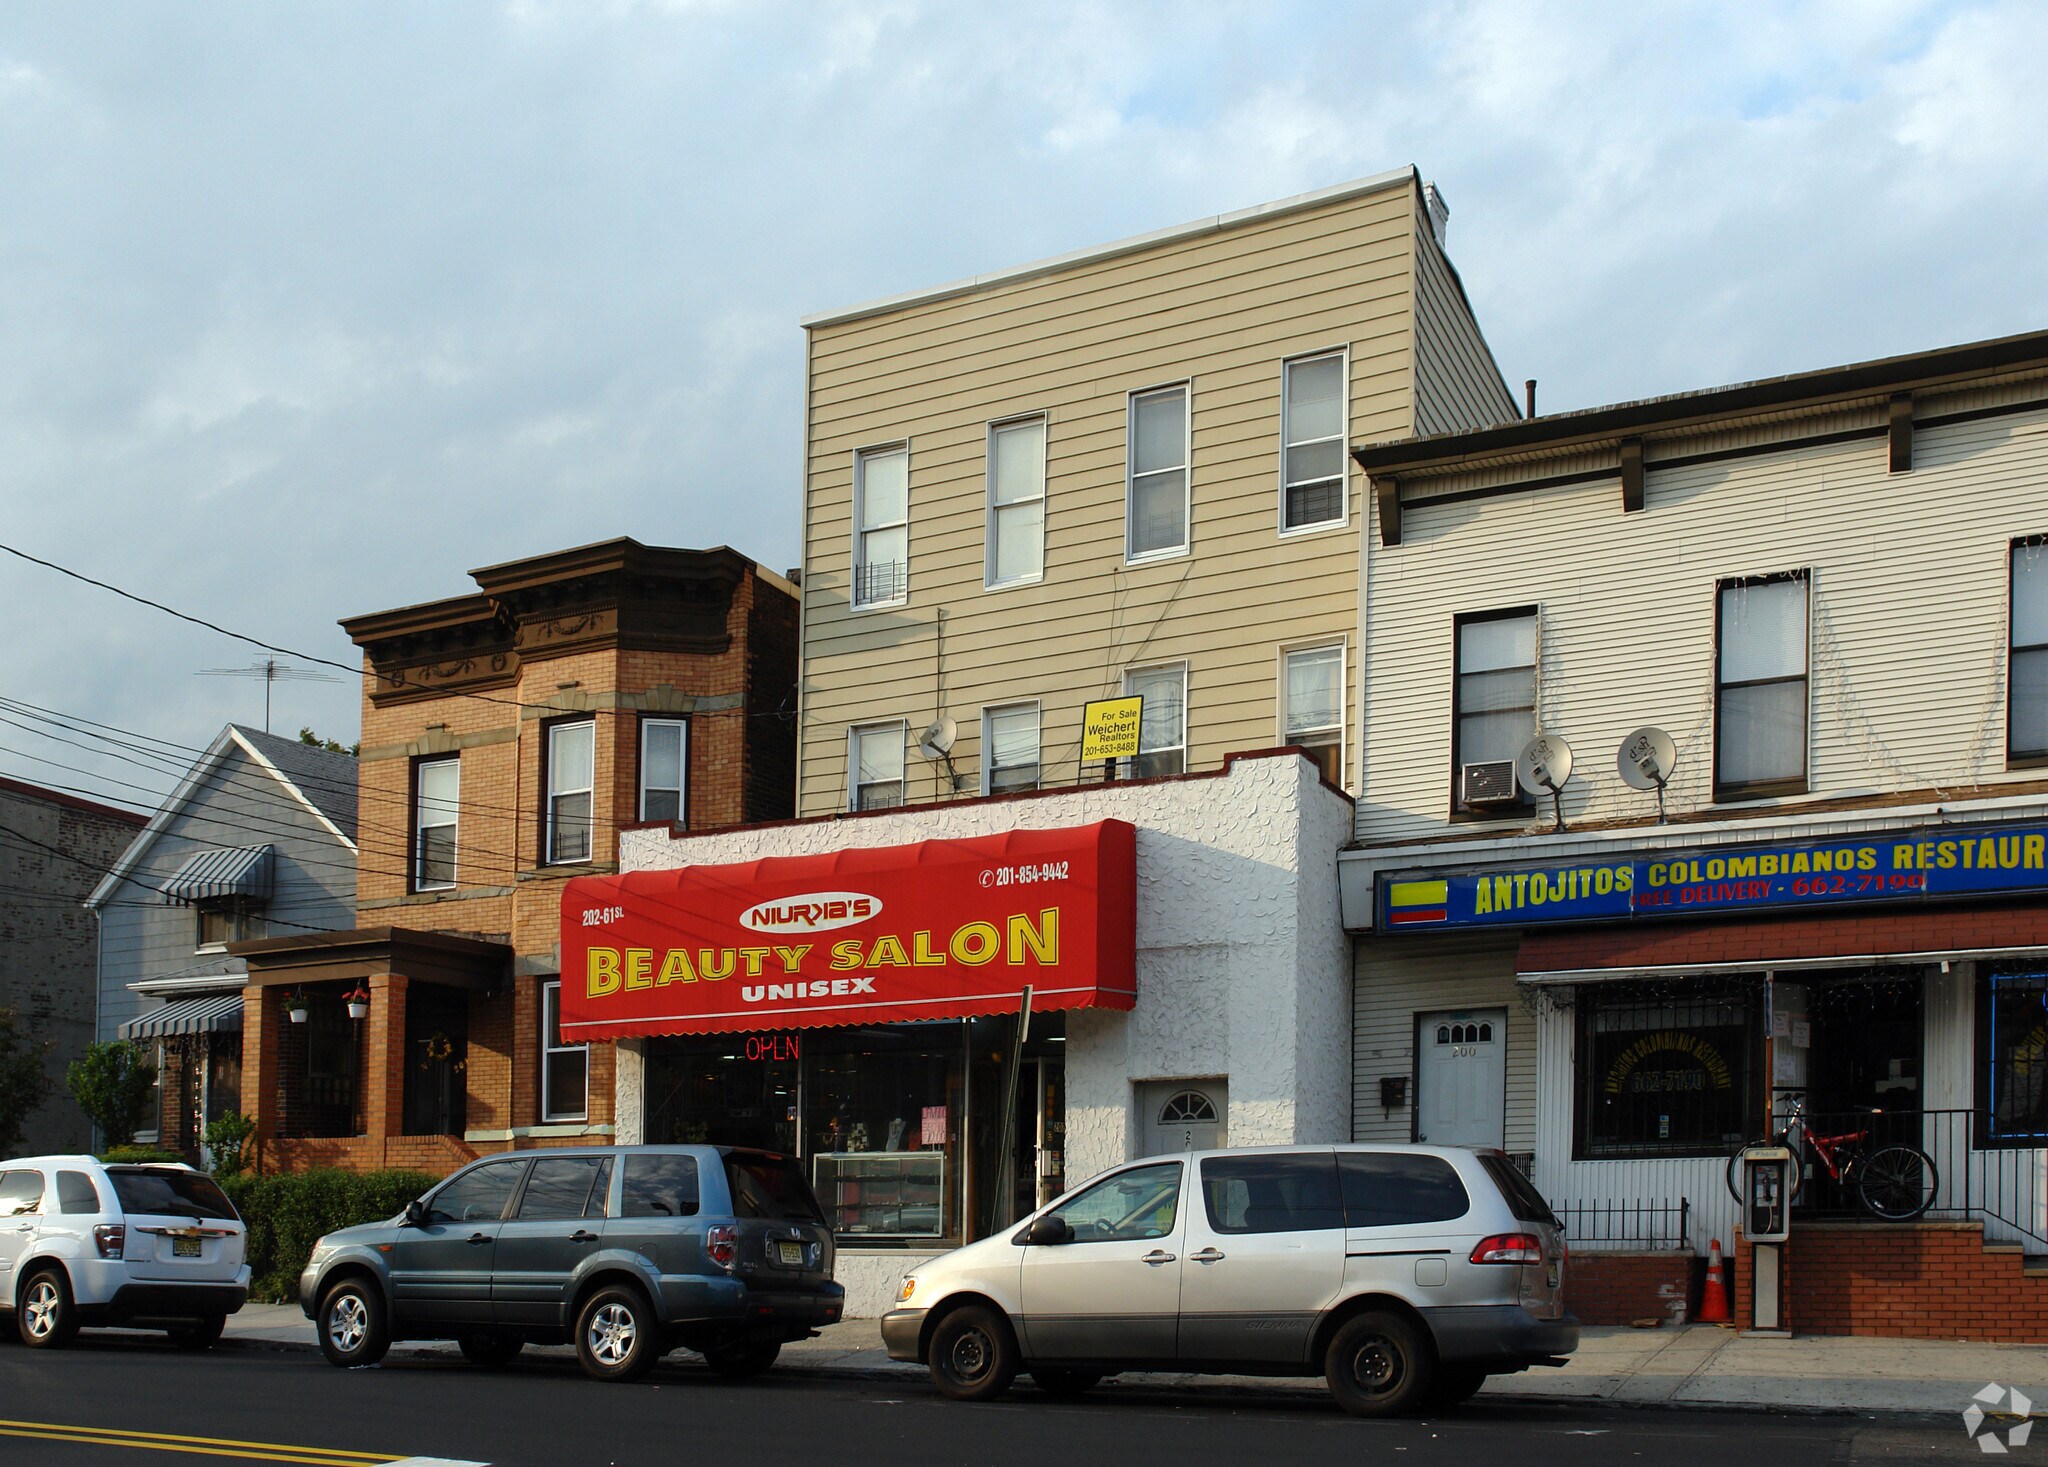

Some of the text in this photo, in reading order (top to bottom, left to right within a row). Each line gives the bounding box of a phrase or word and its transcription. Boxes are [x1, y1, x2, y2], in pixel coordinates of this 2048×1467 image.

[1101, 709, 1137, 721] For Sale
[1088, 720, 1136, 737] Weichert
[1099, 732, 1135, 743] Realtors
[996, 861, 1069, 886] 201-854-9442
[1475, 866, 1633, 915] ANTOJITOS
[1648, 847, 1877, 887] COLOMBIANOS
[1630, 889, 1674, 906] FREE
[1680, 879, 1772, 904] DELIVERY
[1791, 874, 1926, 897] 662-7190
[586, 906, 1059, 999] BEAUTY SALON
[741, 976, 877, 1002] UNISEX
[1452, 1046, 1476, 1058] 200
[1245, 1320, 1304, 1330] SIENNA
